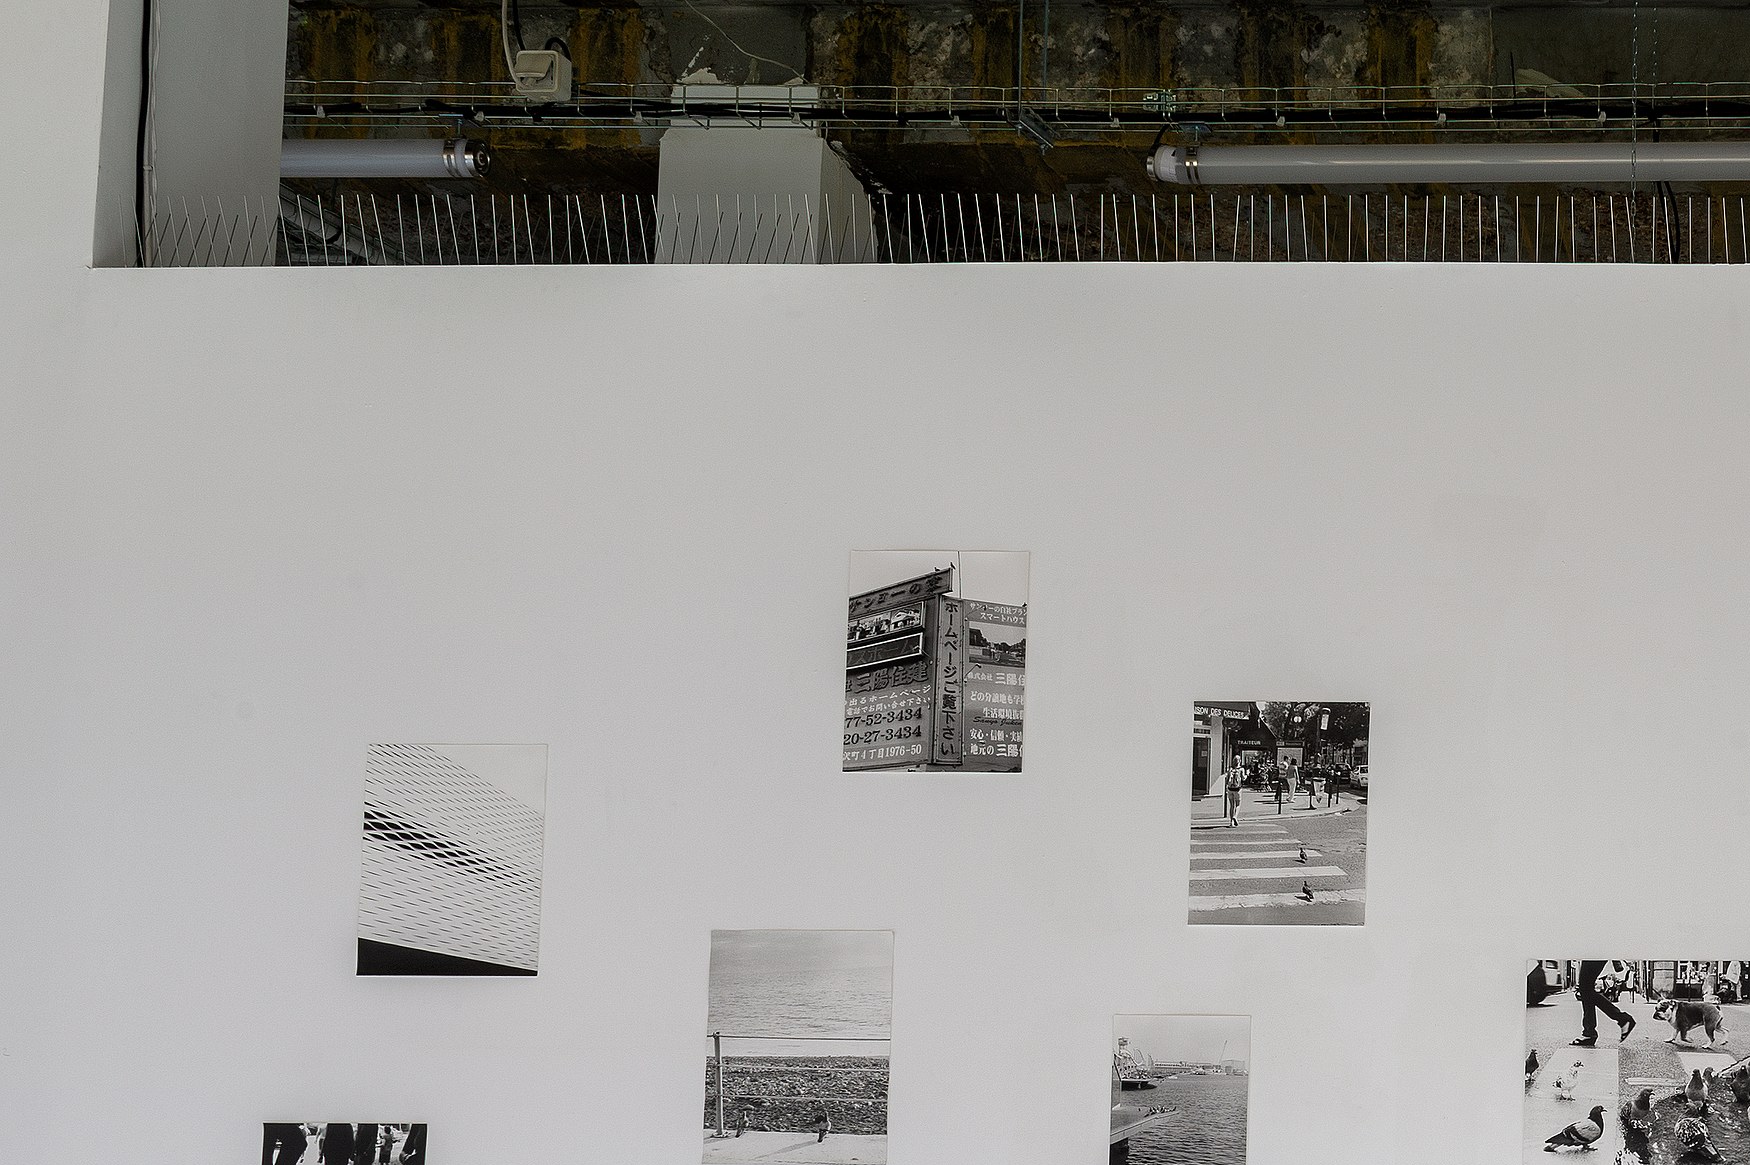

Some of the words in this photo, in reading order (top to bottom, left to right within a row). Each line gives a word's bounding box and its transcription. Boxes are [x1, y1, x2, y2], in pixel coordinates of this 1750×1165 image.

[980, 612, 1025, 625] スマートハウス
[843, 725, 922, 746] 20-27-3434
